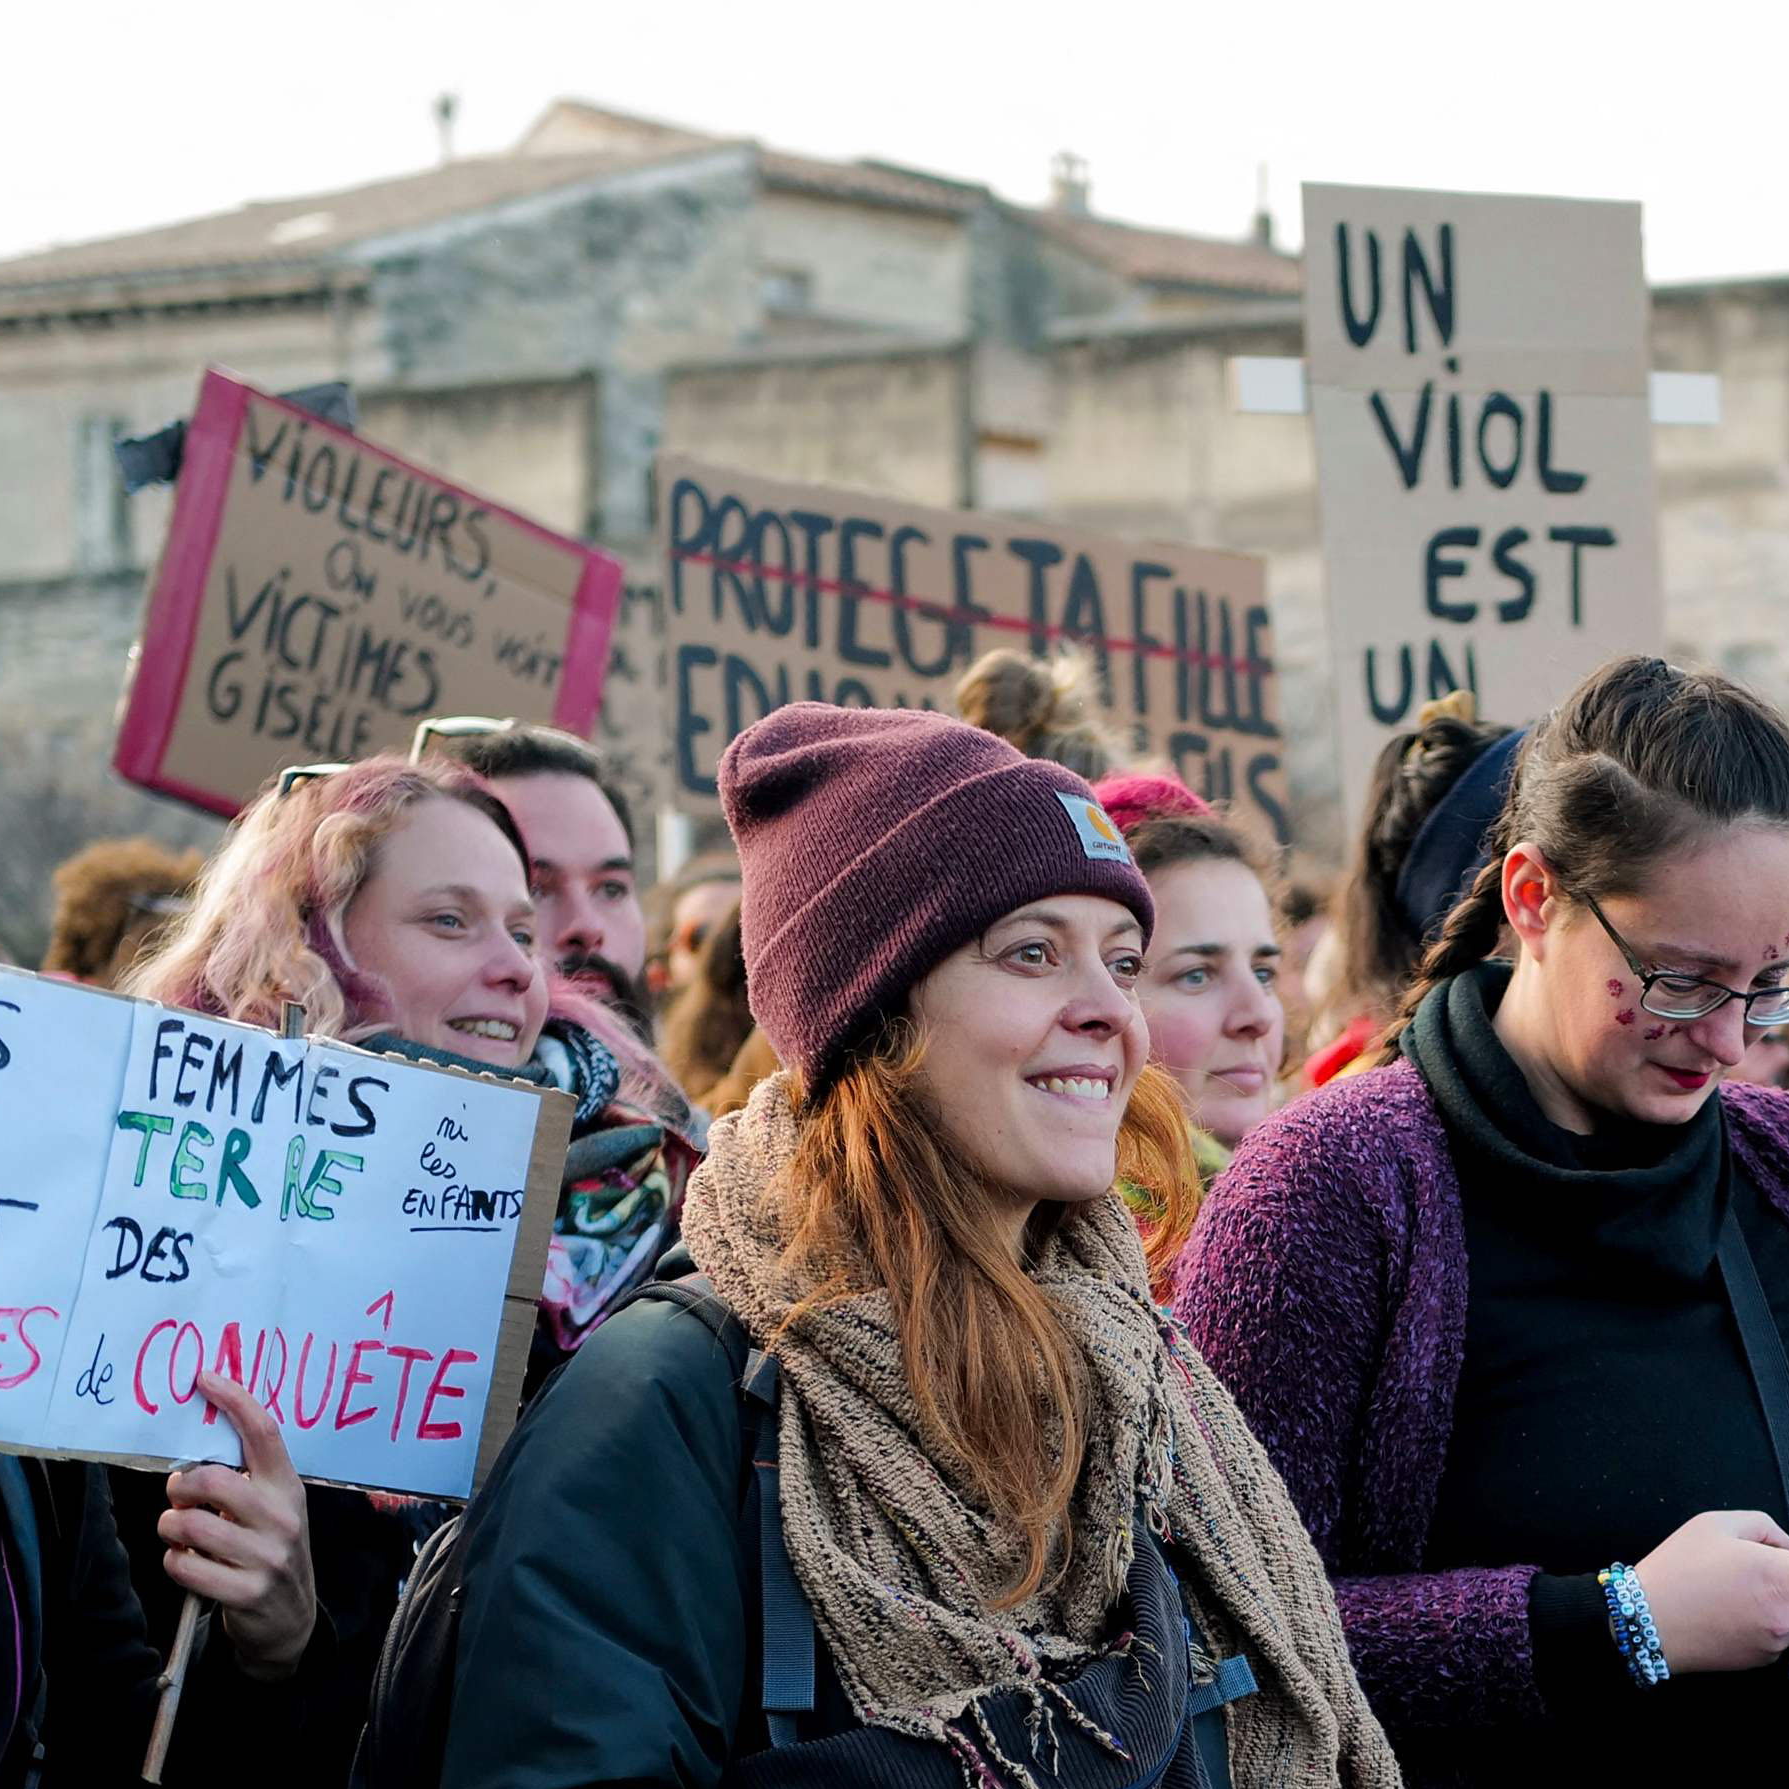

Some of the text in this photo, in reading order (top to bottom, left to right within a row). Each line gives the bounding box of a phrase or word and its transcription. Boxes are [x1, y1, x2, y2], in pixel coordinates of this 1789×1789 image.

[1335, 221, 1456, 355] UN
[670, 477, 992, 678] PROTEGE
[1008, 538, 1115, 707] TA
[1130, 559, 1282, 738] FILLE
[1424, 527, 1617, 626] EST
[1366, 639, 1479, 724] UN
[149, 1019, 390, 1137] FEMMES
[437, 1103, 468, 1141] ni
[117, 1110, 364, 1222] TERRE
[402, 1185, 524, 1222] ENFANTS
[420, 1142, 456, 1179] les
[102, 1216, 194, 1283] DES
[75, 1333, 115, 1405] de
[133, 1289, 479, 1442] CONQUÊTE
